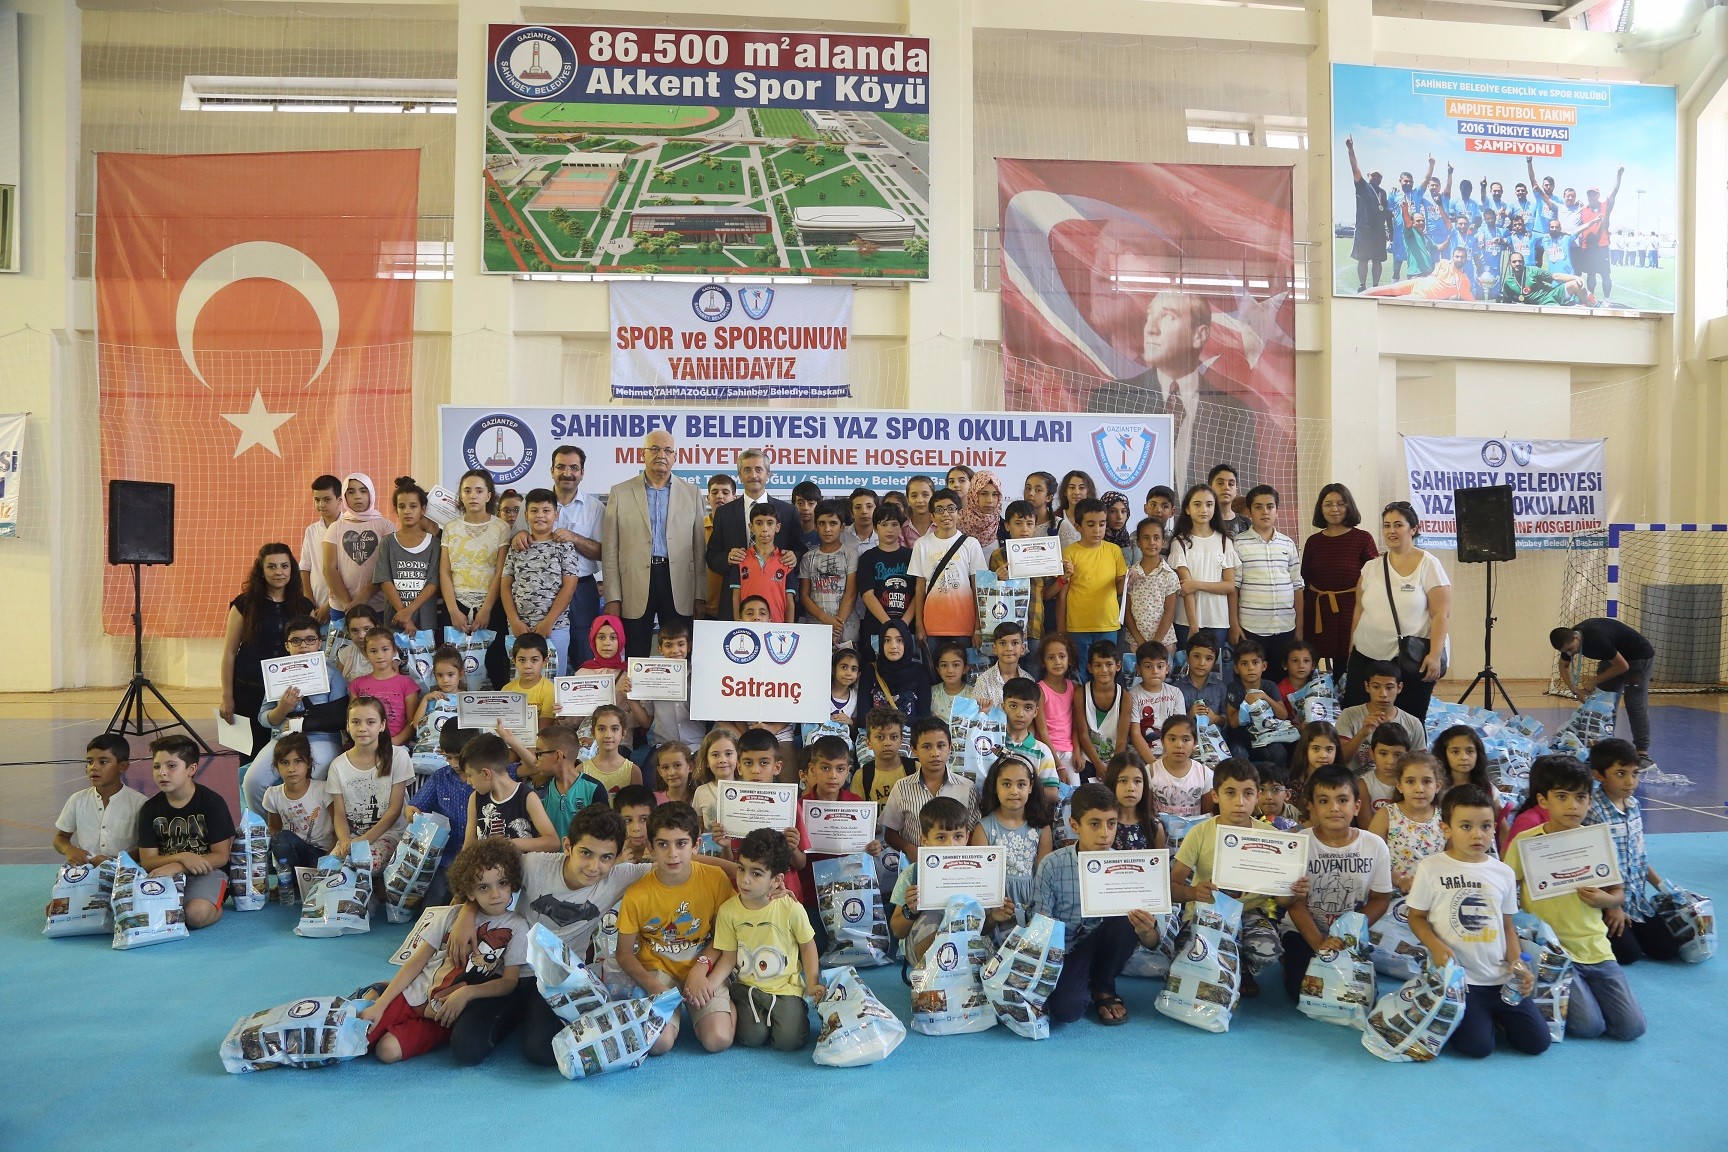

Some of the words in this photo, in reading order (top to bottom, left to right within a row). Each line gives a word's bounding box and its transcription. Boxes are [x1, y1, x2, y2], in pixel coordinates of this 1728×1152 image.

[517, 32, 556, 43] GAZİANTEP
[588, 31, 729, 65] 86.500
[794, 38, 928, 72] alanda
[500, 61, 531, 94] ŞAHİNBEY
[534, 62, 572, 95] BELEDİYESİ
[585, 67, 720, 97] Akkent
[734, 72, 821, 105] Spor
[835, 75, 925, 109] Köyü
[1415, 78, 1457, 91] ŞAHİNBEY
[1459, 81, 1500, 94] BELEDİYE
[1501, 84, 1536, 97] GENÇLİK
[1549, 89, 1572, 99] SPOR
[1573, 90, 1607, 101] KULÜBÜ
[1450, 101, 1493, 117] AMPUTE
[1495, 105, 1536, 120] FUTBOL
[1538, 108, 1575, 122] TAKIMI
[1460, 122, 1485, 134] 2016
[1531, 127, 1568, 140] KUPASI
[616, 326, 674, 350] SPOR
[681, 331, 707, 350] ve
[714, 326, 847, 350] SPORCUNUN
[668, 357, 796, 380] YANINDAYIZ
[615, 387, 653, 397] Mehmet
[654, 386, 719, 397] TAHMAZOĞLU
[770, 387, 808, 398] Belediye
[811, 387, 846, 398] Başkanı
[481, 418, 518, 429] GAZİANTEP
[833, 416, 878, 439] YAZ
[886, 417, 950, 440] SPOR
[958, 418, 1072, 442] OKULLARI
[499, 448, 533, 481] BELEDİYESİ
[865, 446, 1007, 468] HOŞGELDİNİZ
[1420, 494, 1455, 515] YAZ
[1513, 495, 1595, 516] OKULLARI
[361, 531, 375, 542] You
[1417, 538, 1448, 547] Mehmet
[1544, 538, 1575, 548] Belediye
[352, 551, 368, 562] LOVE
[888, 592, 905, 600] CUSTOM
[721, 675, 802, 704] Satranç
[1308, 858, 1373, 875] ADVENTURES
